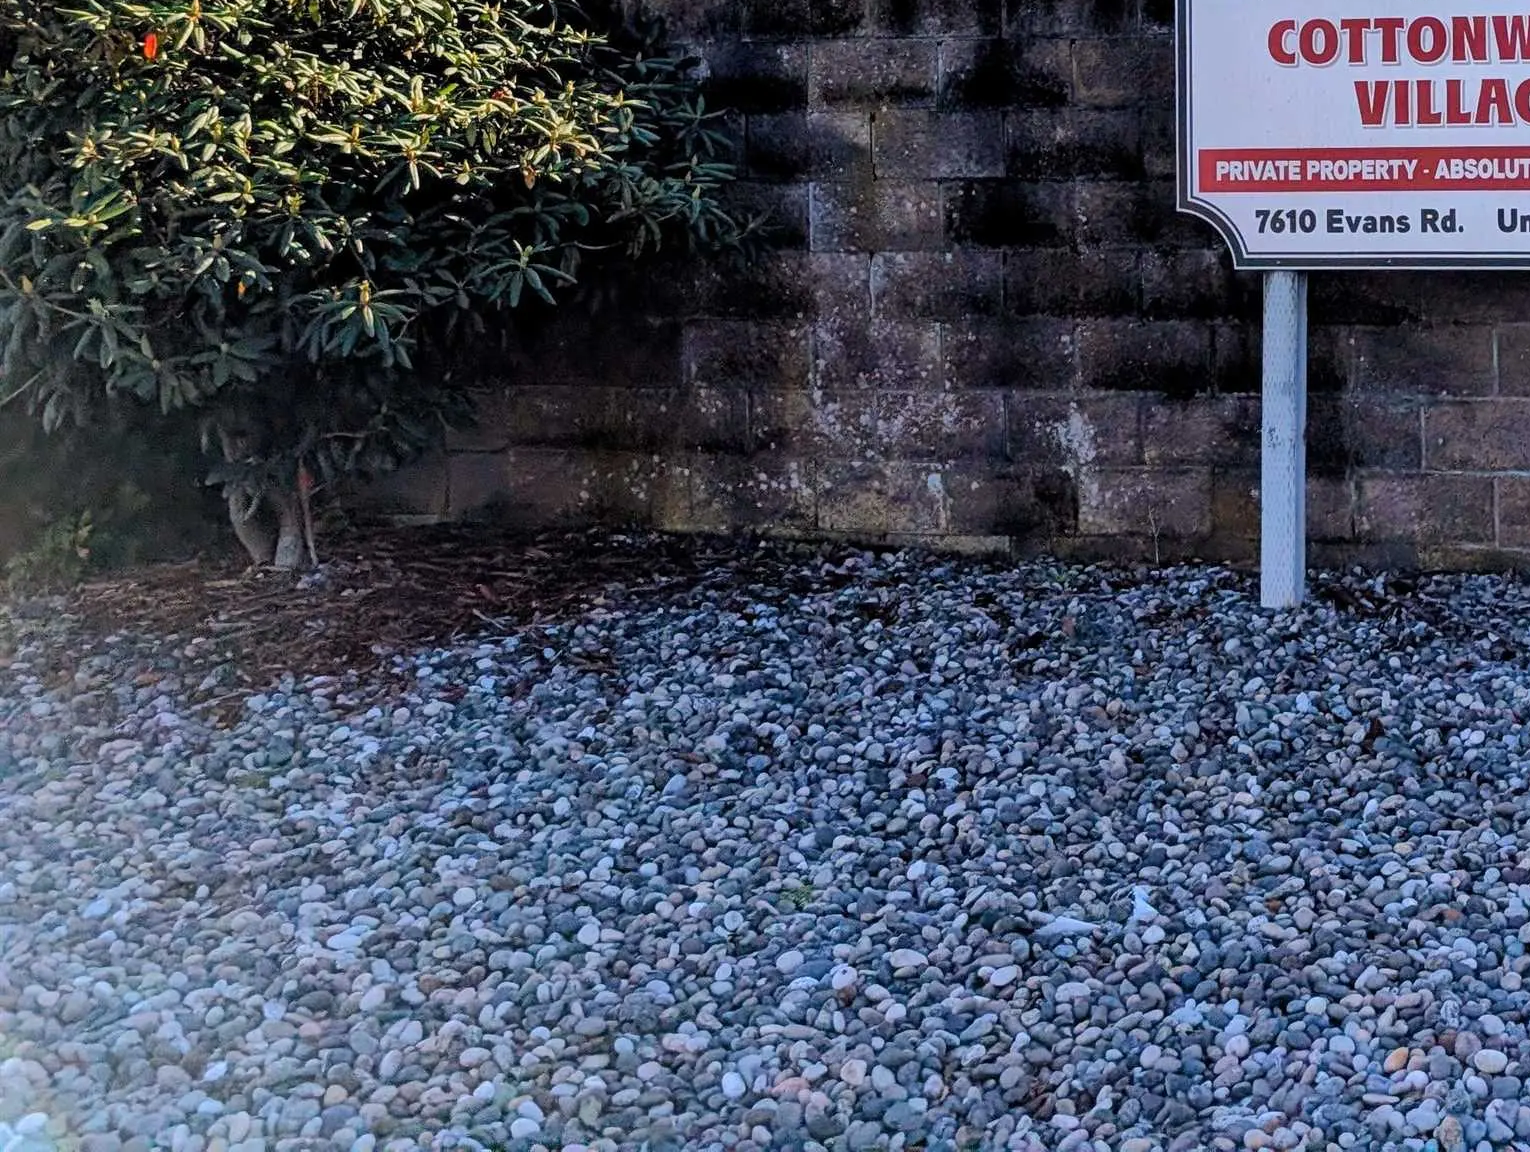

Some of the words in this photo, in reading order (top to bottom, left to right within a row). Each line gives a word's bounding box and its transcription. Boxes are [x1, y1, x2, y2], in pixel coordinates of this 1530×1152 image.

[1215, 160, 1301, 181] PRIVATE
[1306, 159, 1418, 180] PROPERTY
[1255, 209, 1317, 233] 7610
[1326, 209, 1411, 233] Evans
[1420, 208, 1465, 233] Rd.
